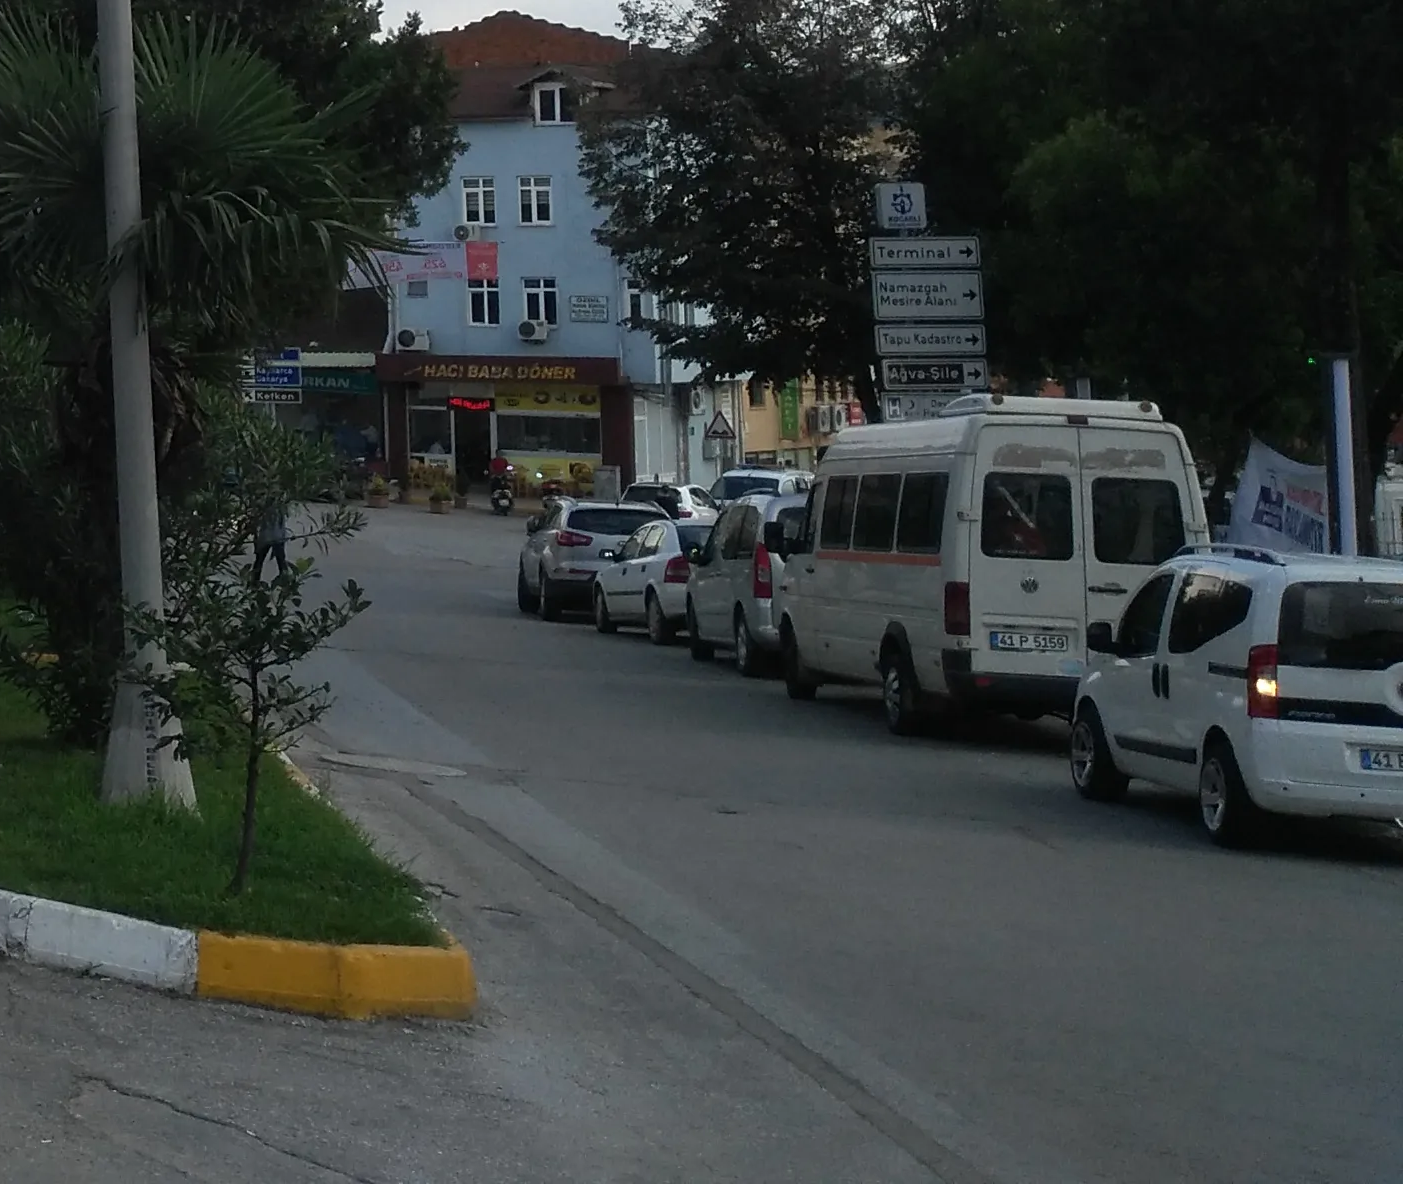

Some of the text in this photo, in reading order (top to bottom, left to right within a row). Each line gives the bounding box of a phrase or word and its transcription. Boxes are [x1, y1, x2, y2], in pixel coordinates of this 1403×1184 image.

[876, 246, 951, 259] Terminal
[878, 281, 947, 296] Namazgah
[879, 296, 922, 306] Mesire
[882, 333, 962, 346] Tapu Kadastro
[889, 366, 959, 383] Ağva-Şile
[256, 391, 295, 401] Kefken
[999, 634, 1065, 649] 41 P 5159
[1372, 752, 1393, 768] 41
